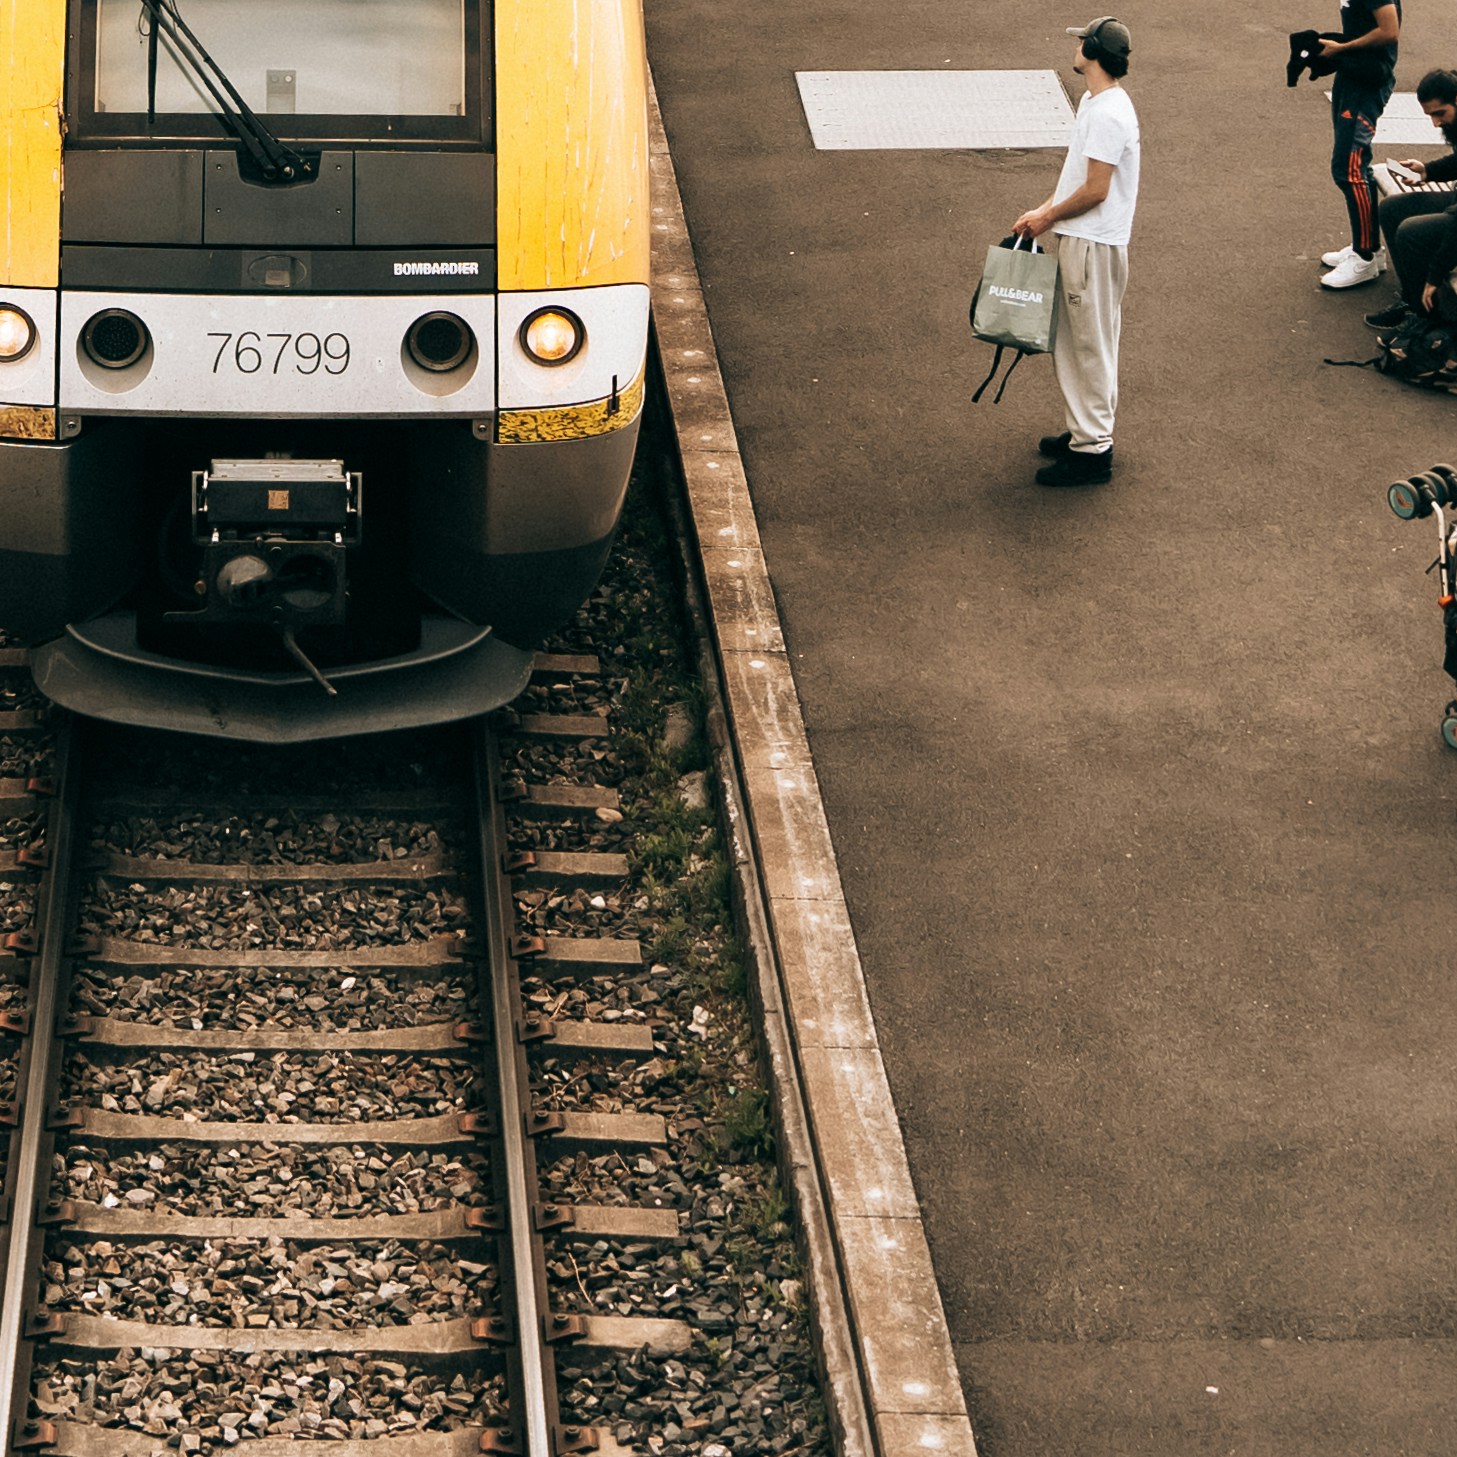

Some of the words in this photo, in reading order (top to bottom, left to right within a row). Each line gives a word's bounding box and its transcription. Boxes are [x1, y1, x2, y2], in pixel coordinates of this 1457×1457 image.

[393, 262, 479, 276] BOMBARDIER
[989, 285, 1044, 304] PULL&BEAR
[207, 331, 350, 375] 76799
